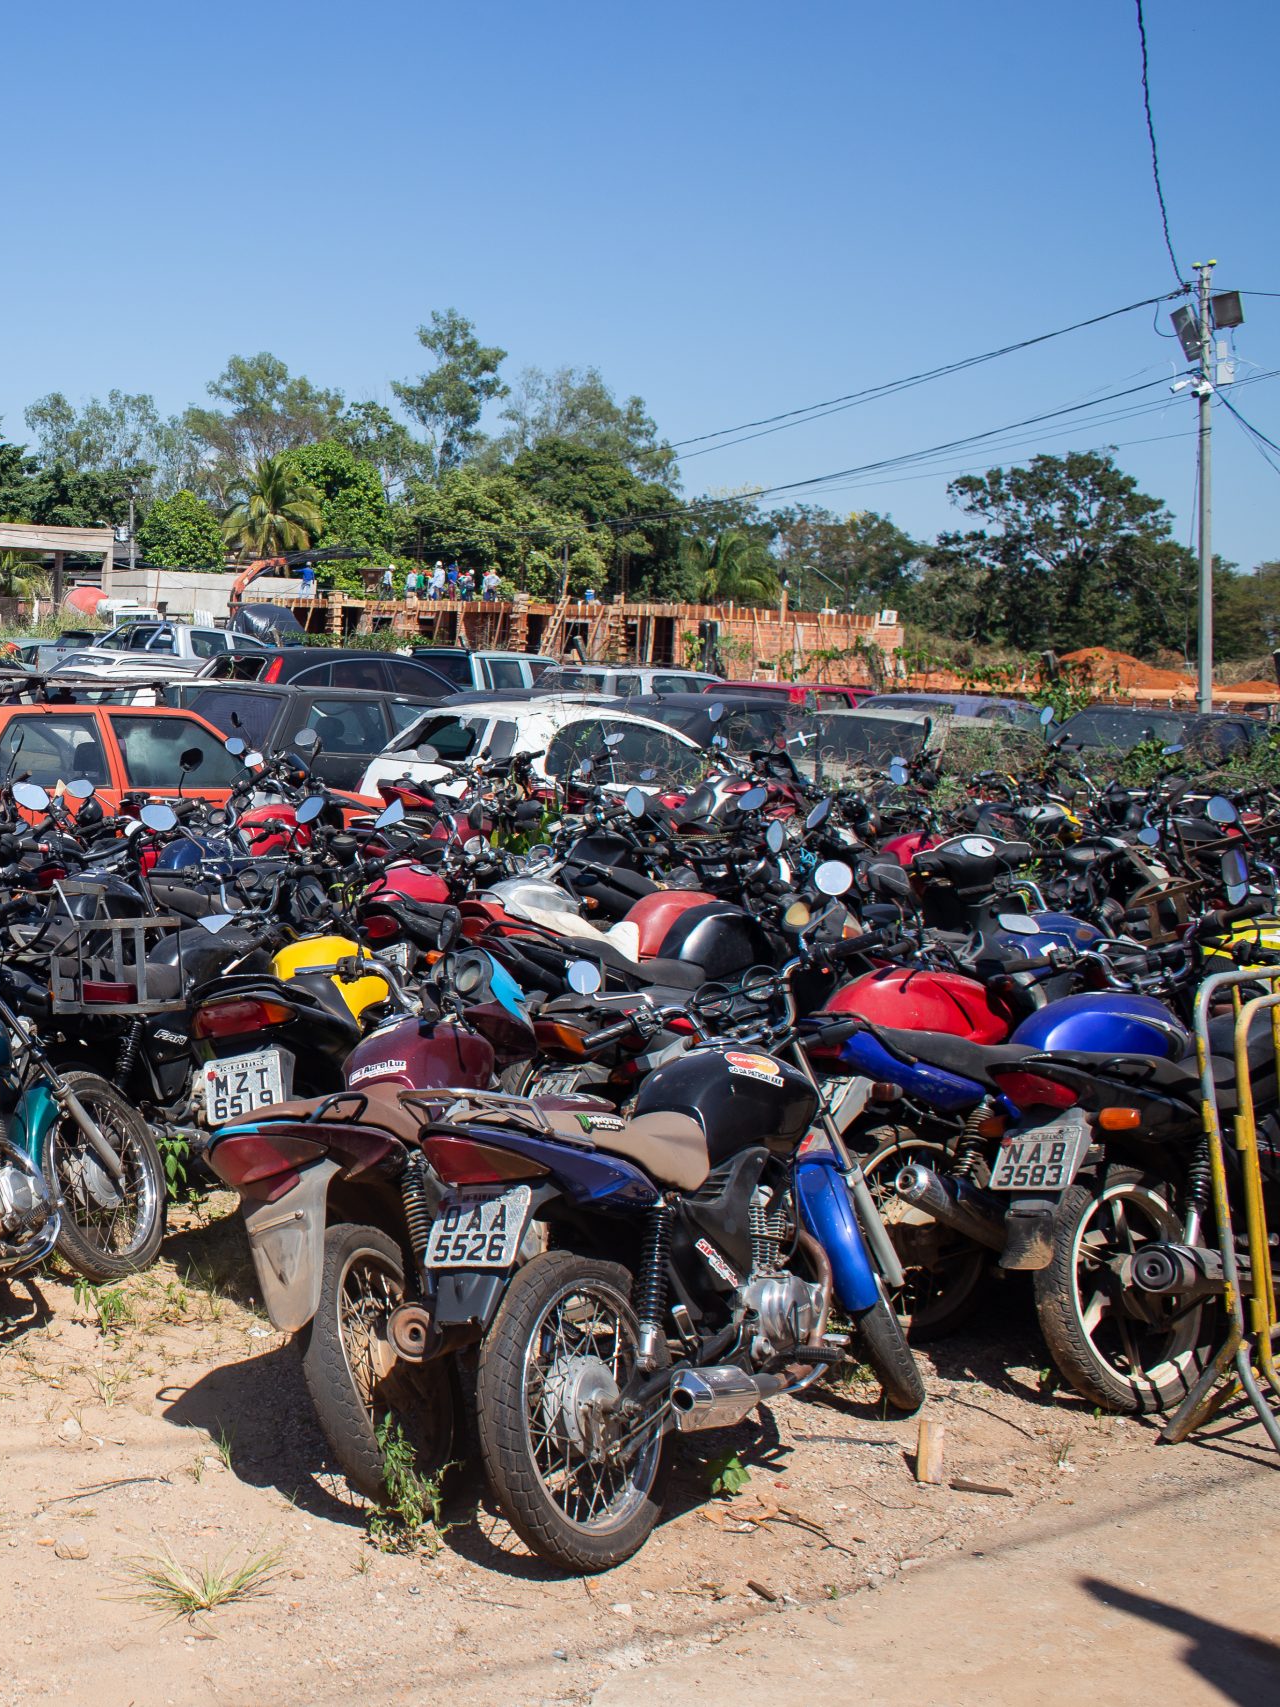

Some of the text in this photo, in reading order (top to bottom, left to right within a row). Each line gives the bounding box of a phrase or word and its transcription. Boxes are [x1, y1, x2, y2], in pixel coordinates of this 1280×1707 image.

[215, 1067, 269, 1098] MZT
[363, 1062, 387, 1074] Acre
[214, 1089, 275, 1120] 6519
[1005, 1142, 1067, 1165] NAB
[996, 1164, 1064, 1187] 3583
[442, 1203, 507, 1233] OAA
[432, 1233, 507, 1263] 5526
